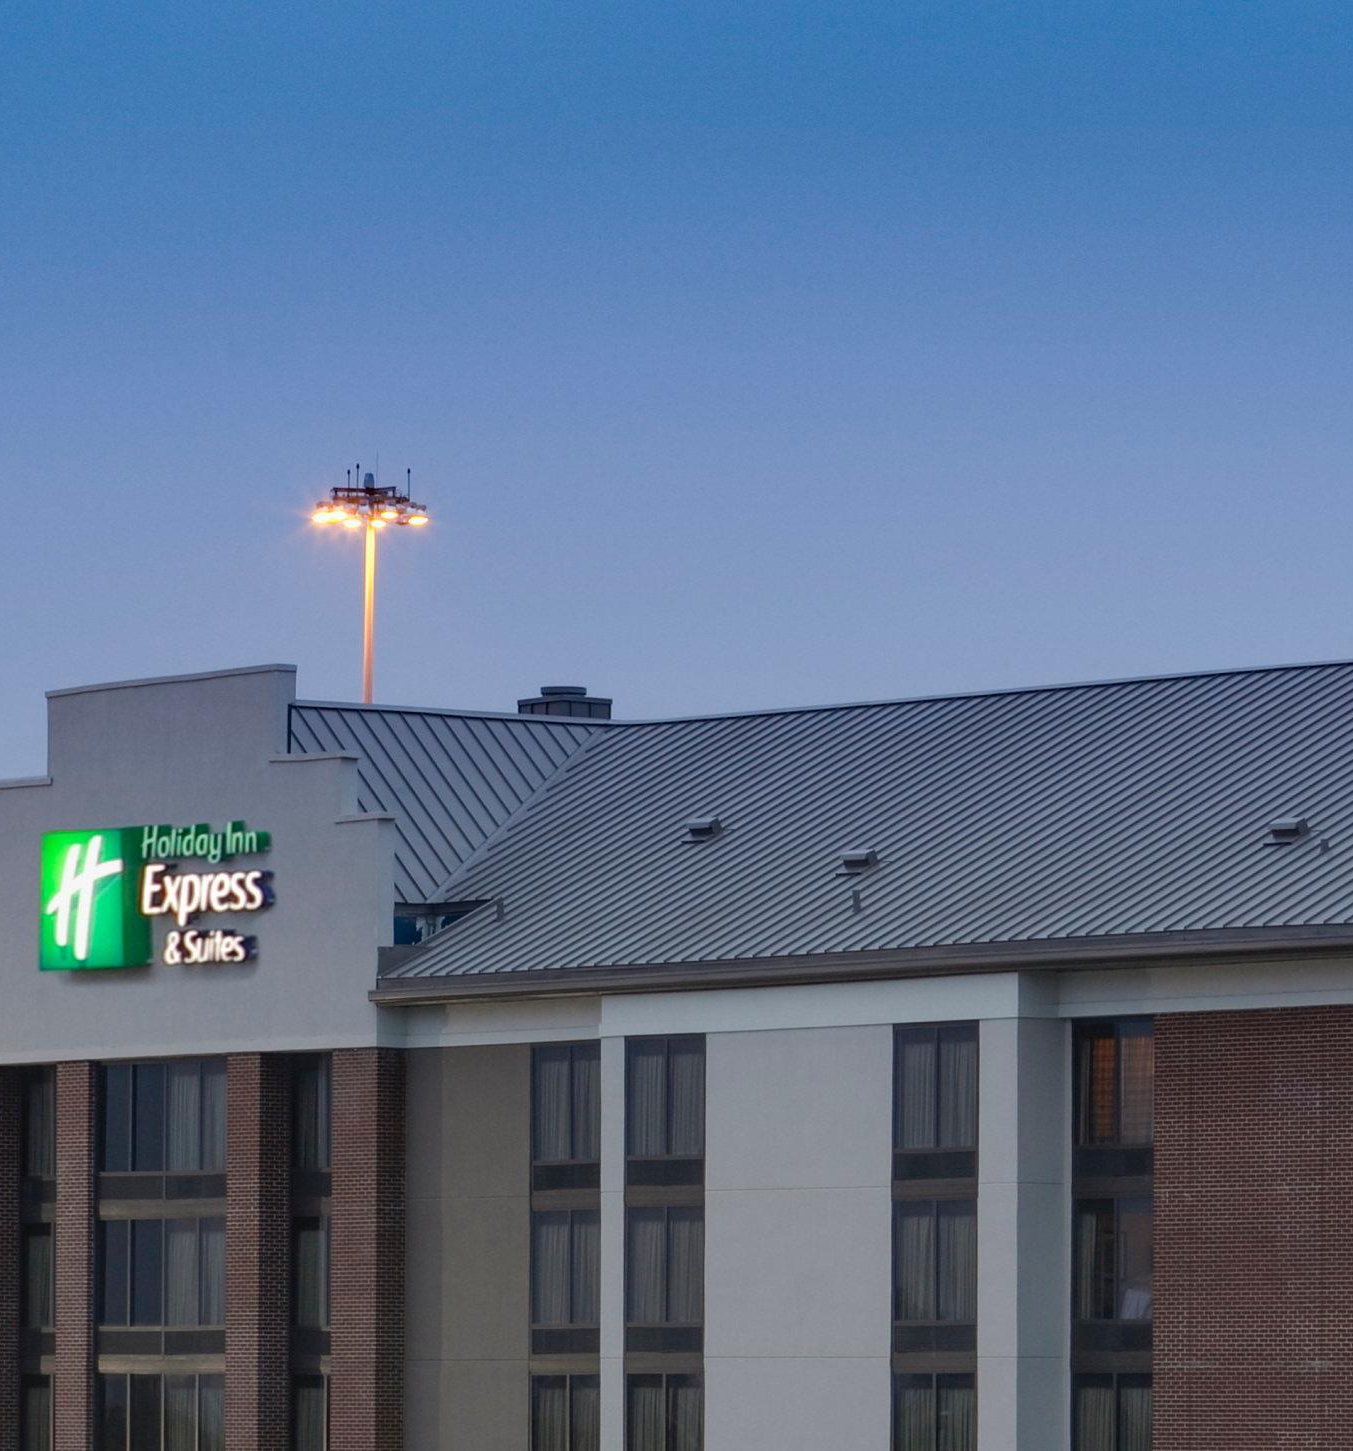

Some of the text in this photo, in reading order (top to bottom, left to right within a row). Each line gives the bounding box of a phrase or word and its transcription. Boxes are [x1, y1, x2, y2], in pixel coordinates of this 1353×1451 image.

[142, 821, 258, 864] Holiday Inn
[141, 863, 264, 927] Express
[163, 930, 247, 966] & Suites
